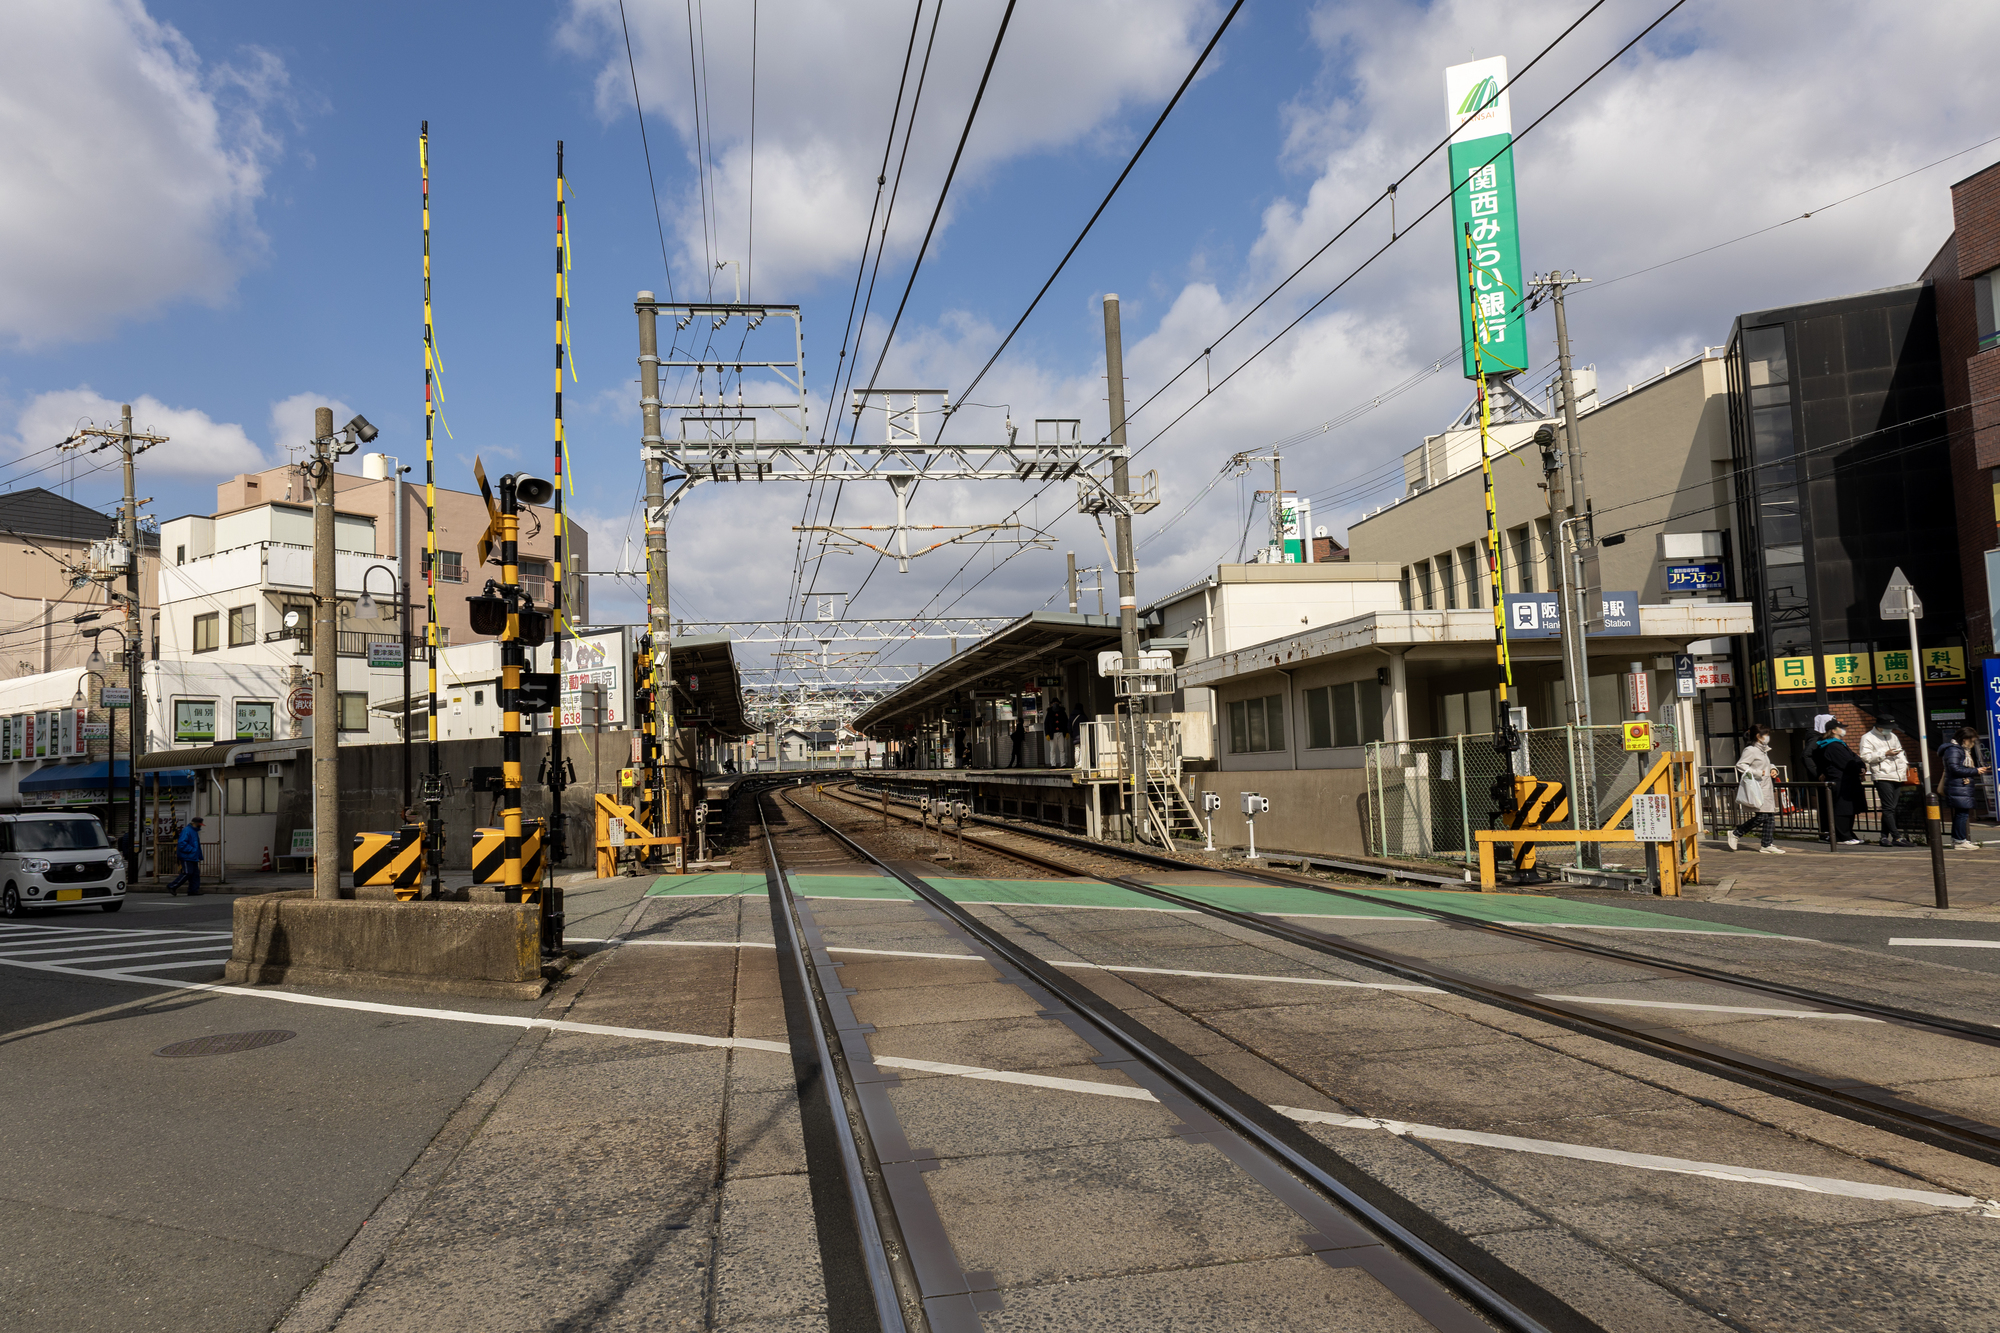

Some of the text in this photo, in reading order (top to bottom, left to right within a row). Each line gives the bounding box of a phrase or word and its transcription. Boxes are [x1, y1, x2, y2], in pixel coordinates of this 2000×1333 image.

[1468, 163, 1507, 344] 関西みらい銀行
[1669, 571, 1722, 584] フリーステップ
[1541, 602, 1559, 618] 阪
[194, 708, 257, 717] 個別 指導
